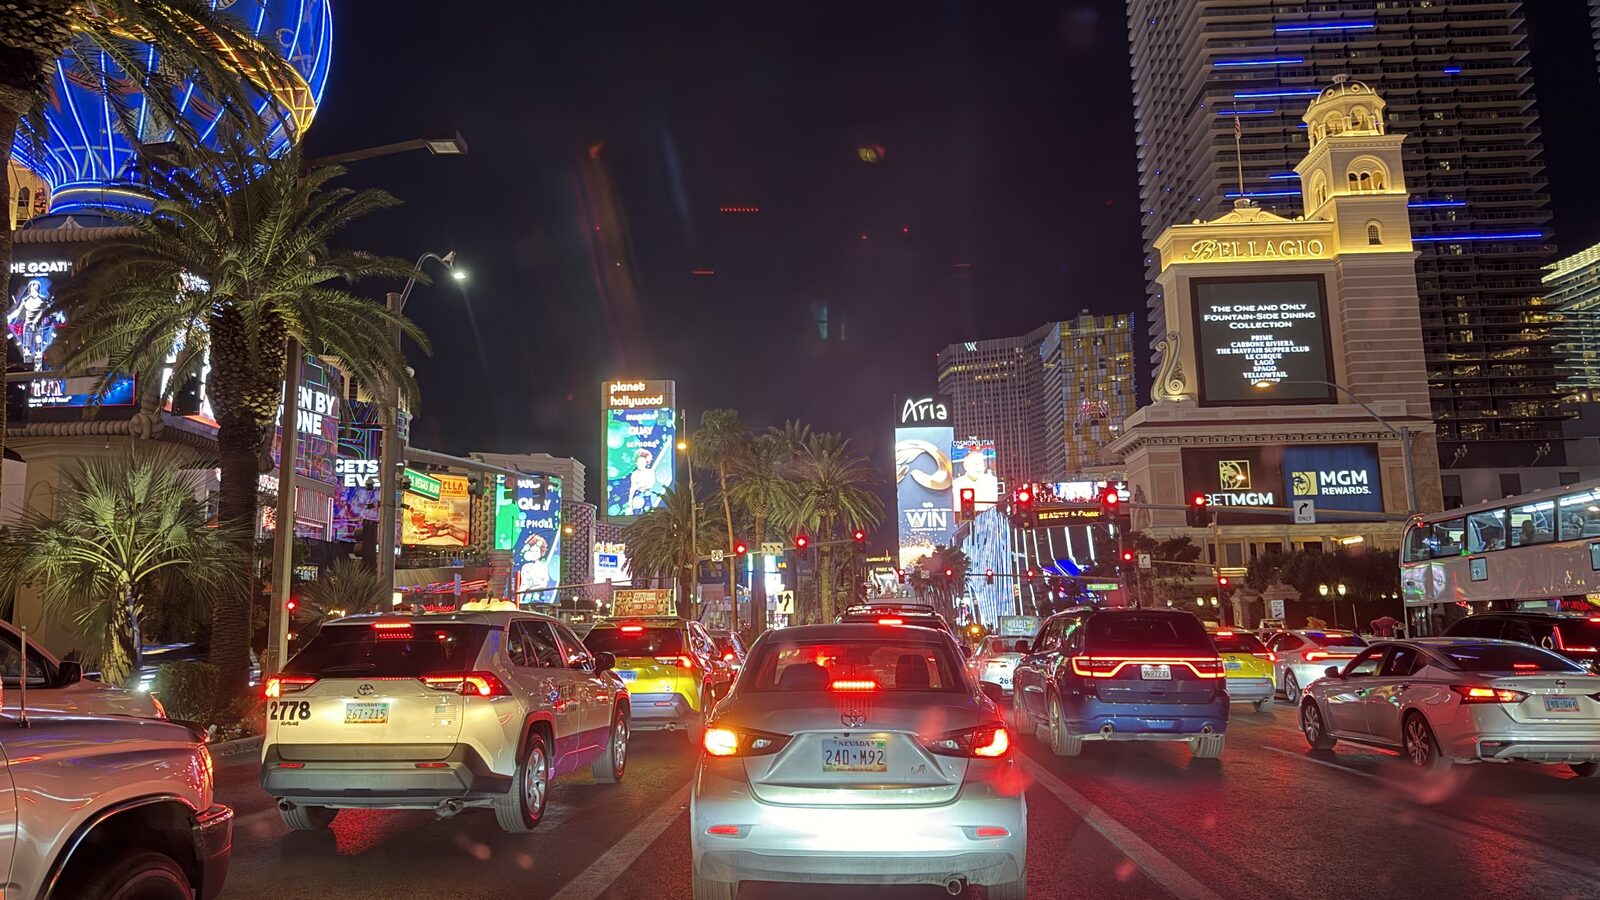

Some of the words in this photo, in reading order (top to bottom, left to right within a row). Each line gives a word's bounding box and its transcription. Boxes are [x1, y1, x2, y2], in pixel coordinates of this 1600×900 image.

[1229, 321, 1292, 329] COLLECTION
[1243, 371, 1288, 379] YELLOWTAIL
[610, 381, 646, 395] planet
[315, 391, 335, 416] BY
[610, 395, 663, 408] hollywood
[901, 397, 948, 423] Aria
[415, 477, 428, 491] VEGAS
[1320, 470, 1368, 486] MGM
[906, 511, 947, 528] WIN
[270, 701, 311, 720] 2778
